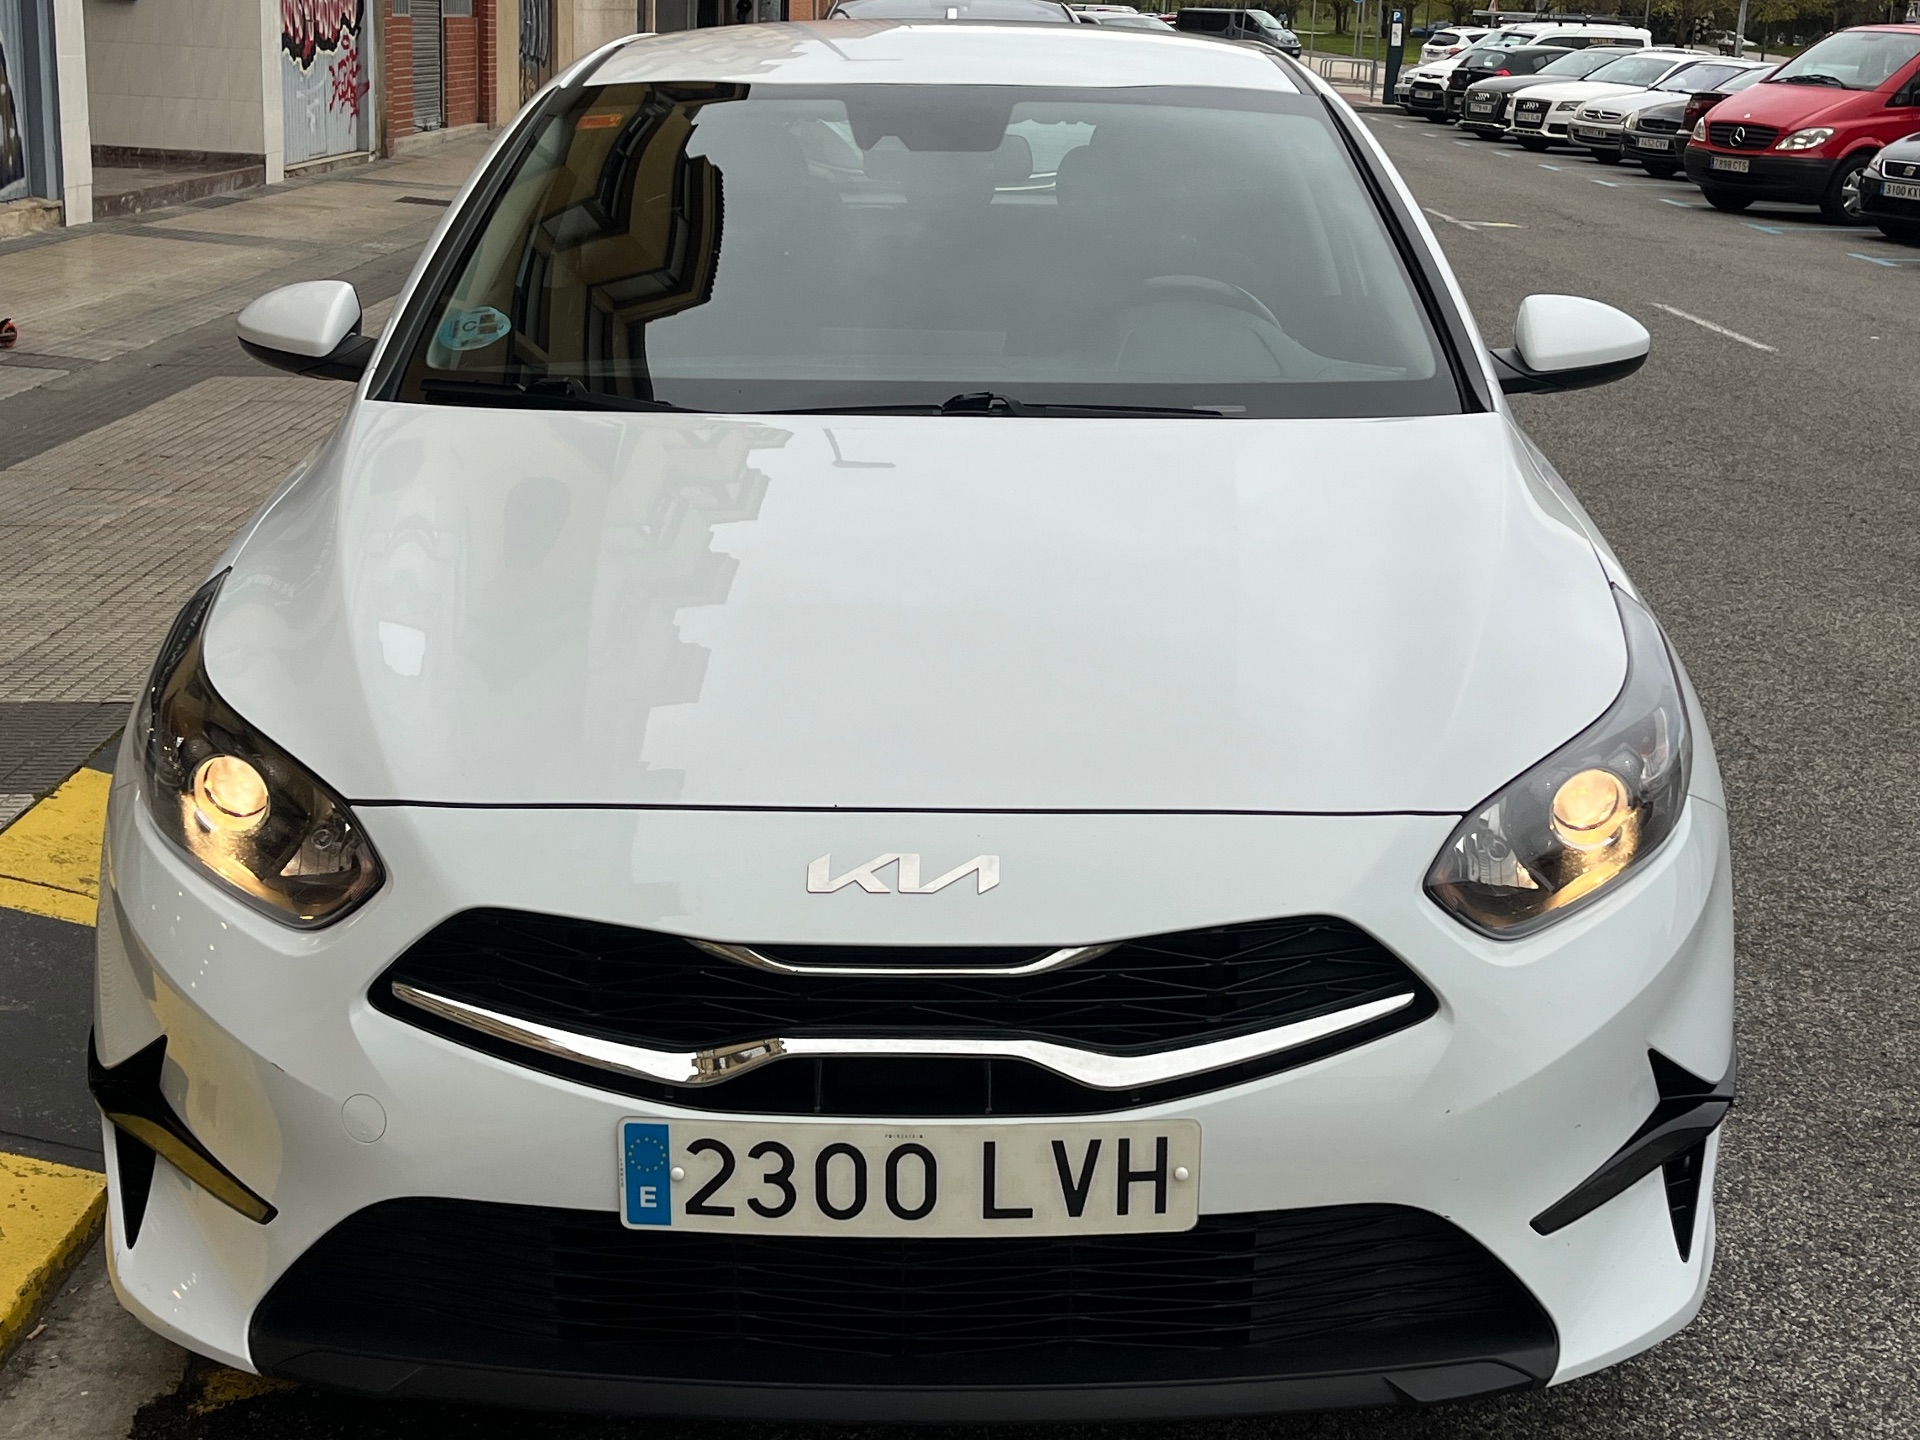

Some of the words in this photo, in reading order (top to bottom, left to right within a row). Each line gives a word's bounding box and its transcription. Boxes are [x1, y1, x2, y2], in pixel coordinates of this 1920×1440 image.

[1393, 12, 1400, 21] P
[1733, 160, 1747, 171] CTS
[1886, 184, 1906, 196] 3100
[1907, 187, 1920, 198] KX
[806, 853, 1000, 895] KIA
[685, 1138, 938, 1221] 2300
[982, 1136, 1168, 1220] LVH
[640, 1186, 657, 1208] E
